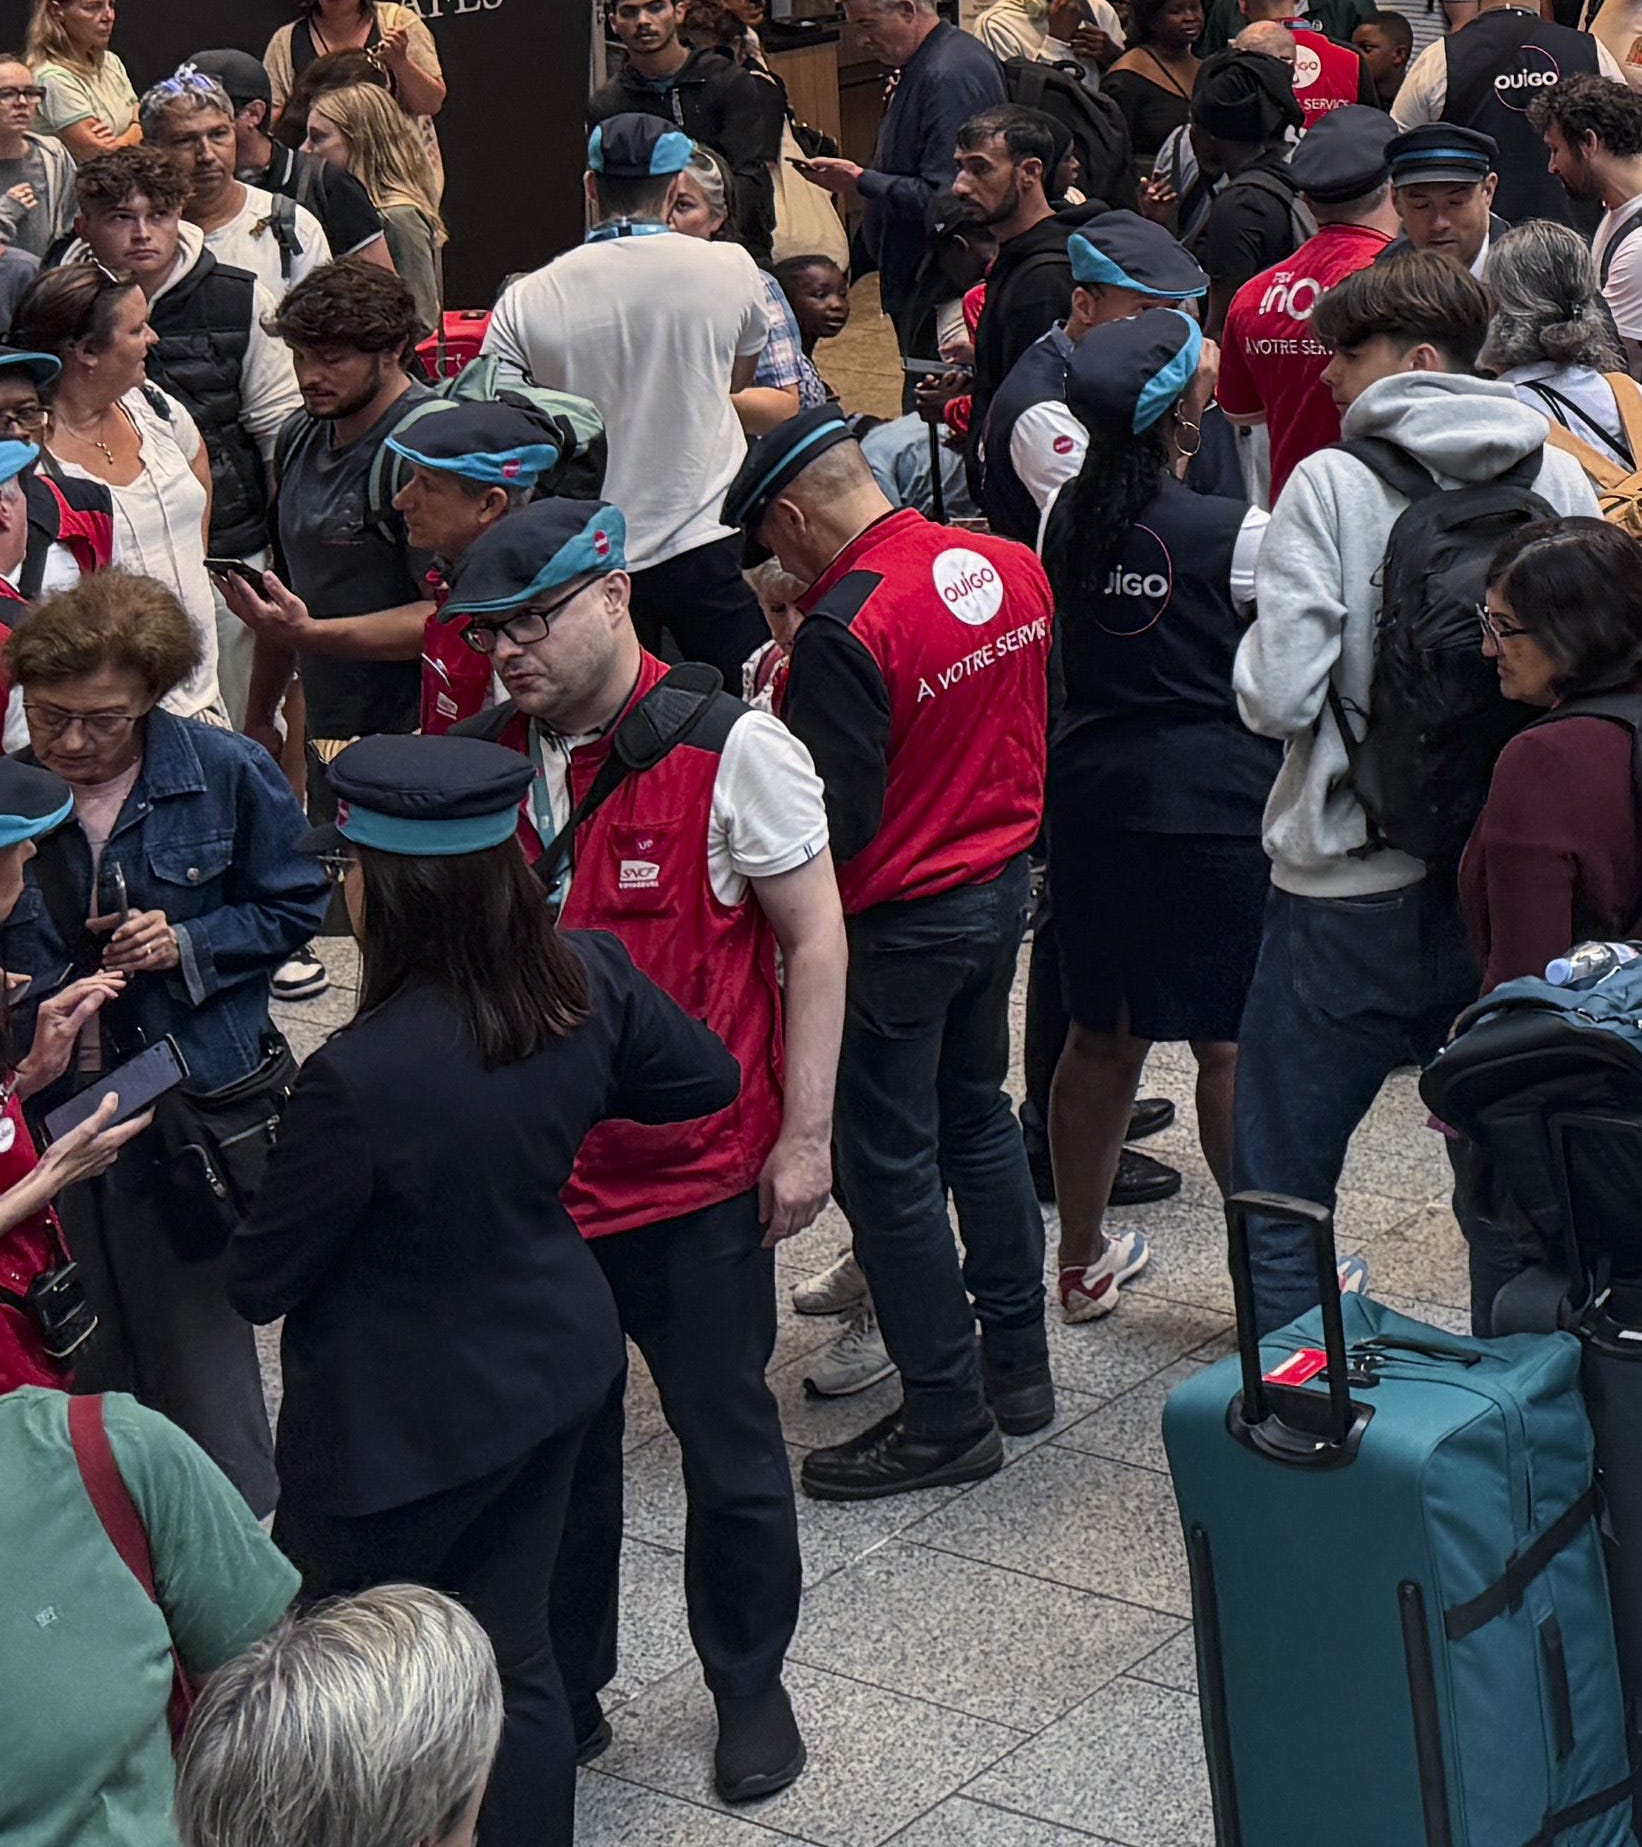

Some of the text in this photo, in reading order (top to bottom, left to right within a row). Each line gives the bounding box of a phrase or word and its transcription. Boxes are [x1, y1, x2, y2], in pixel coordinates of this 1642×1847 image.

[917, 678, 935, 703] À
[938, 643, 995, 691] VOTRE
[623, 867, 656, 879] SNCF
